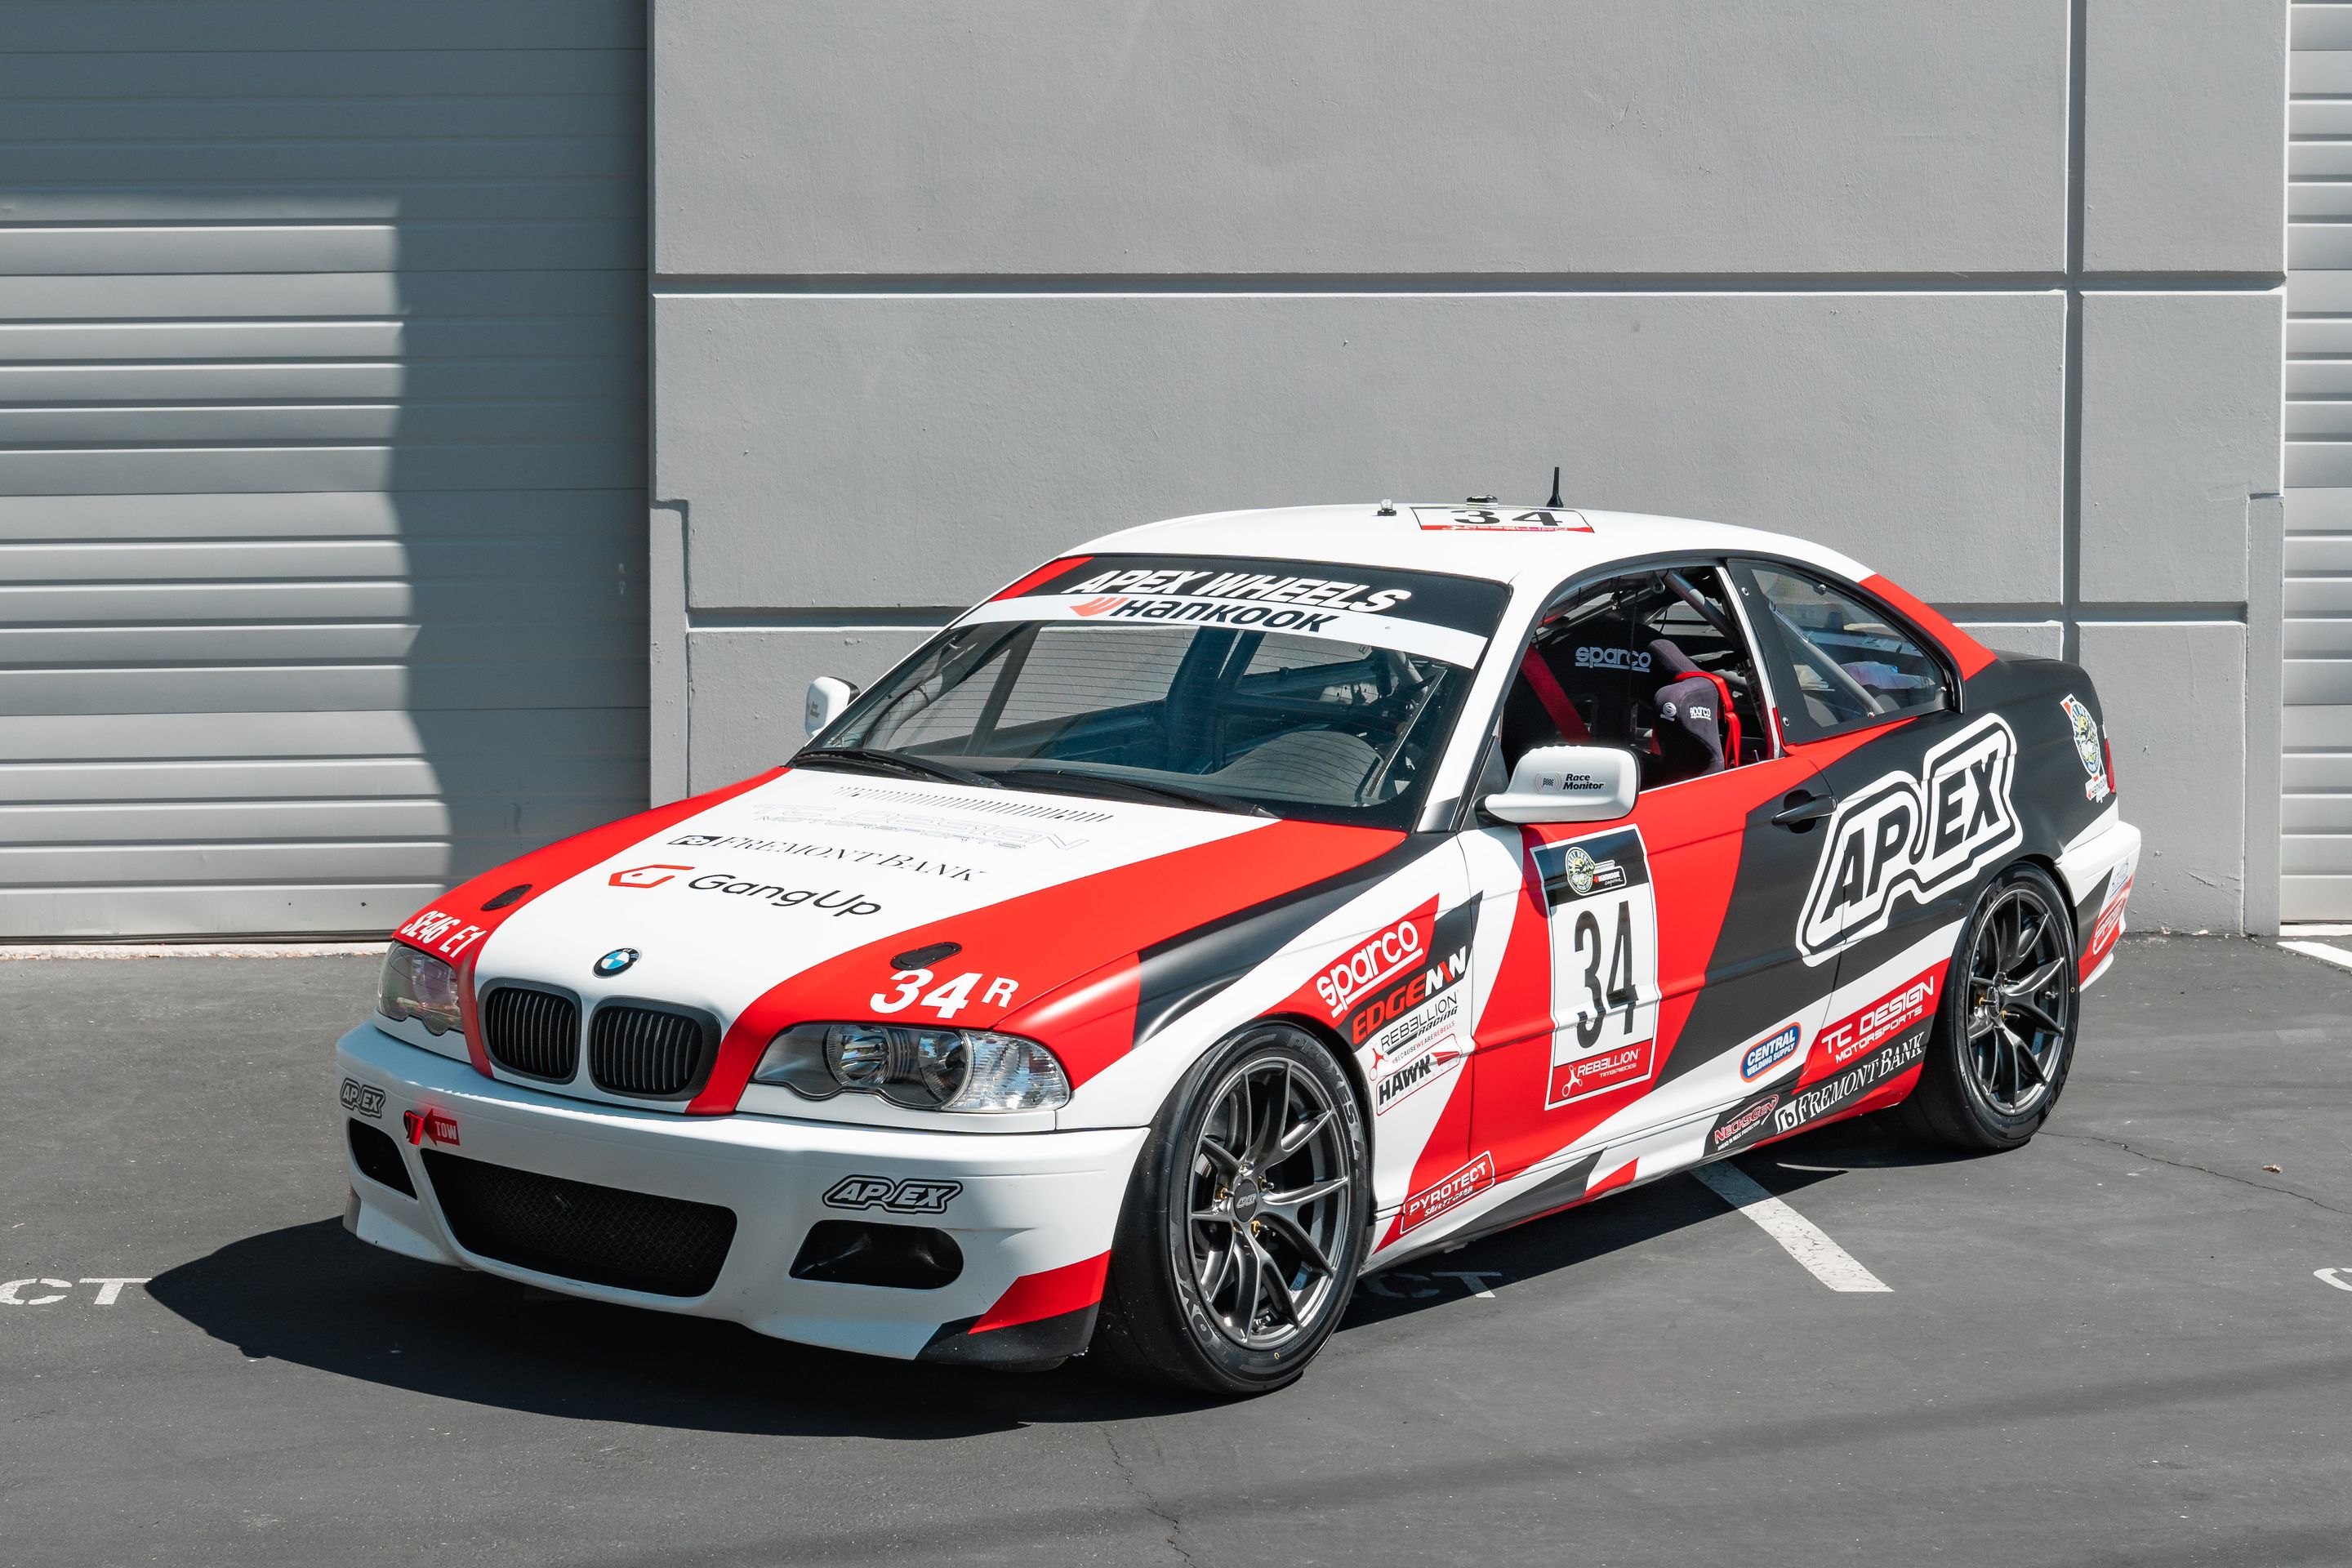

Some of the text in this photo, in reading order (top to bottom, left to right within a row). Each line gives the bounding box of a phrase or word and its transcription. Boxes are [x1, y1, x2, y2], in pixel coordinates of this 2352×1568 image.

[1450, 510, 1563, 527] 34
[1061, 569, 1412, 612] APEX WHEELS
[1575, 646, 1652, 670] sparco
[1562, 782, 1604, 791] Monitor
[1566, 773, 1591, 782] Race
[1819, 746, 2001, 925] APEX
[713, 836, 884, 863] FREMONT
[873, 853, 987, 882] BANK
[688, 873, 882, 917] GangUp
[400, 911, 488, 958] SE46 E1
[1316, 920, 1419, 1013] sparco
[1575, 900, 1639, 1049] 34
[870, 968, 1019, 1019] 34 R
[1821, 975, 1934, 1054] TC DESIGN
[1747, 1029, 1796, 1067] CENTRAL
[1835, 1004, 1923, 1064] MOTORSPORTS
[1379, 1054, 1432, 1106] HAWK
[1746, 1041, 1795, 1076] WELDING SUPPLY
[1797, 1058, 1880, 1125] FREMONT
[1878, 1031, 1925, 1078] BANK
[341, 1083, 382, 1113] APEX
[434, 1120, 458, 1140] TOW
[831, 1181, 951, 1209] APEX
[1409, 1161, 1486, 1216] PYROTECT
[1357, 1271, 1503, 1298] CT
